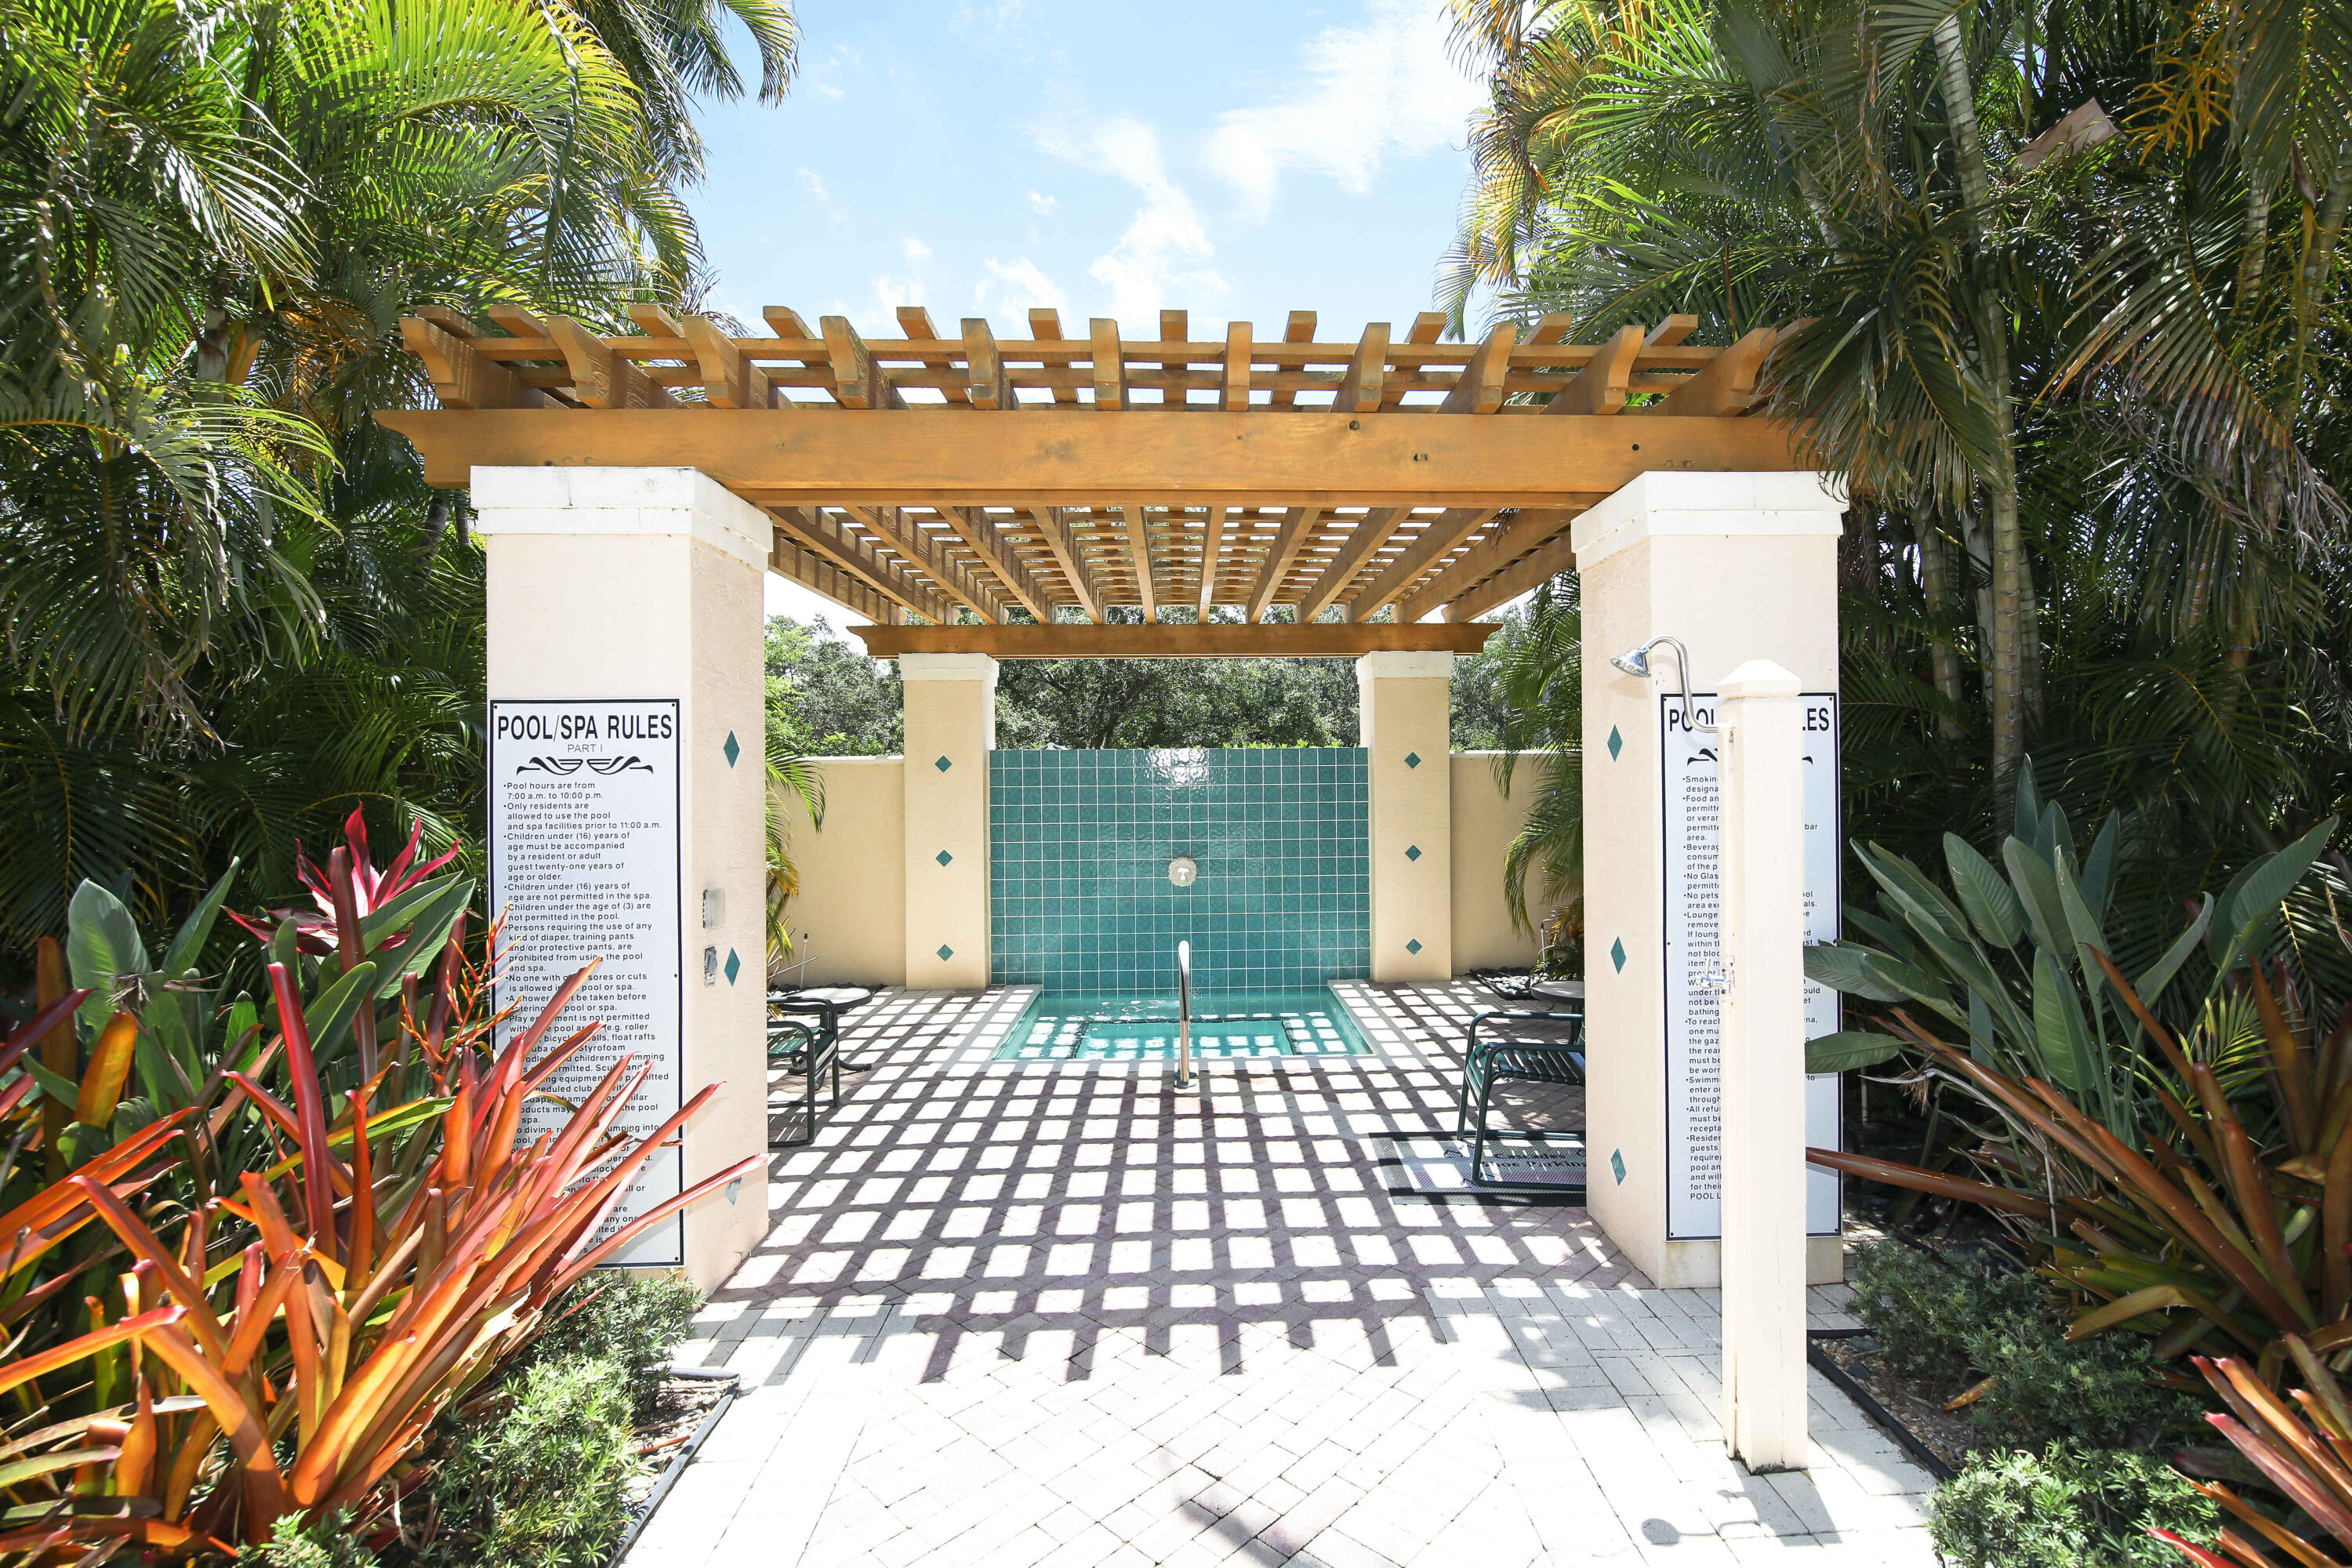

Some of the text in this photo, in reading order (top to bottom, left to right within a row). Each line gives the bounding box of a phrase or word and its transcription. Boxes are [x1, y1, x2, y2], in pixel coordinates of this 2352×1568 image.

[498, 714, 672, 742] POOL/SPA RULES
[567, 743, 597, 753] PART
[506, 802, 528, 811] Only
[590, 811, 611, 821] pool
[526, 823, 543, 832] spa
[585, 822, 607, 831] prior
[506, 832, 545, 840] Children
[575, 832, 591, 841] (16)
[593, 833, 619, 841] years
[564, 841, 625, 851] accompanied
[507, 853, 518, 862] by
[507, 863, 533, 873] guest
[535, 863, 586, 872] twenty-one
[507, 874, 524, 883] age
[507, 883, 546, 891] Children
[576, 882, 591, 891] (16)
[560, 892, 604, 902] permitted
[507, 903, 546, 912] Children
[622, 902, 634, 911] (3)
[524, 913, 568, 923] permitted
[597, 913, 619, 922] pool.
[546, 923, 587, 933] requiring
[540, 934, 571, 943] diaper,
[572, 933, 606, 942] training
[608, 933, 634, 942] pants
[539, 943, 585, 953] protective
[587, 943, 615, 953] pants,
[509, 953, 554, 964] prohibited
[622, 953, 643, 962] pool
[528, 965, 546, 974] spa.
[508, 974, 521, 982] No
[509, 984, 517, 993] is
[581, 983, 602, 993] pool
[563, 1004, 585, 1014] pool
[510, 1014, 528, 1023] Play
[606, 1012, 650, 1023] permitted
[554, 1025, 574, 1033] pool
[625, 1022, 648, 1031] roller
[573, 1054, 619, 1062] children's
[552, 1103, 659, 1115] may pool
[1690, 1144, 1719, 1153] guests
[1690, 1163, 1709, 1173] pool
